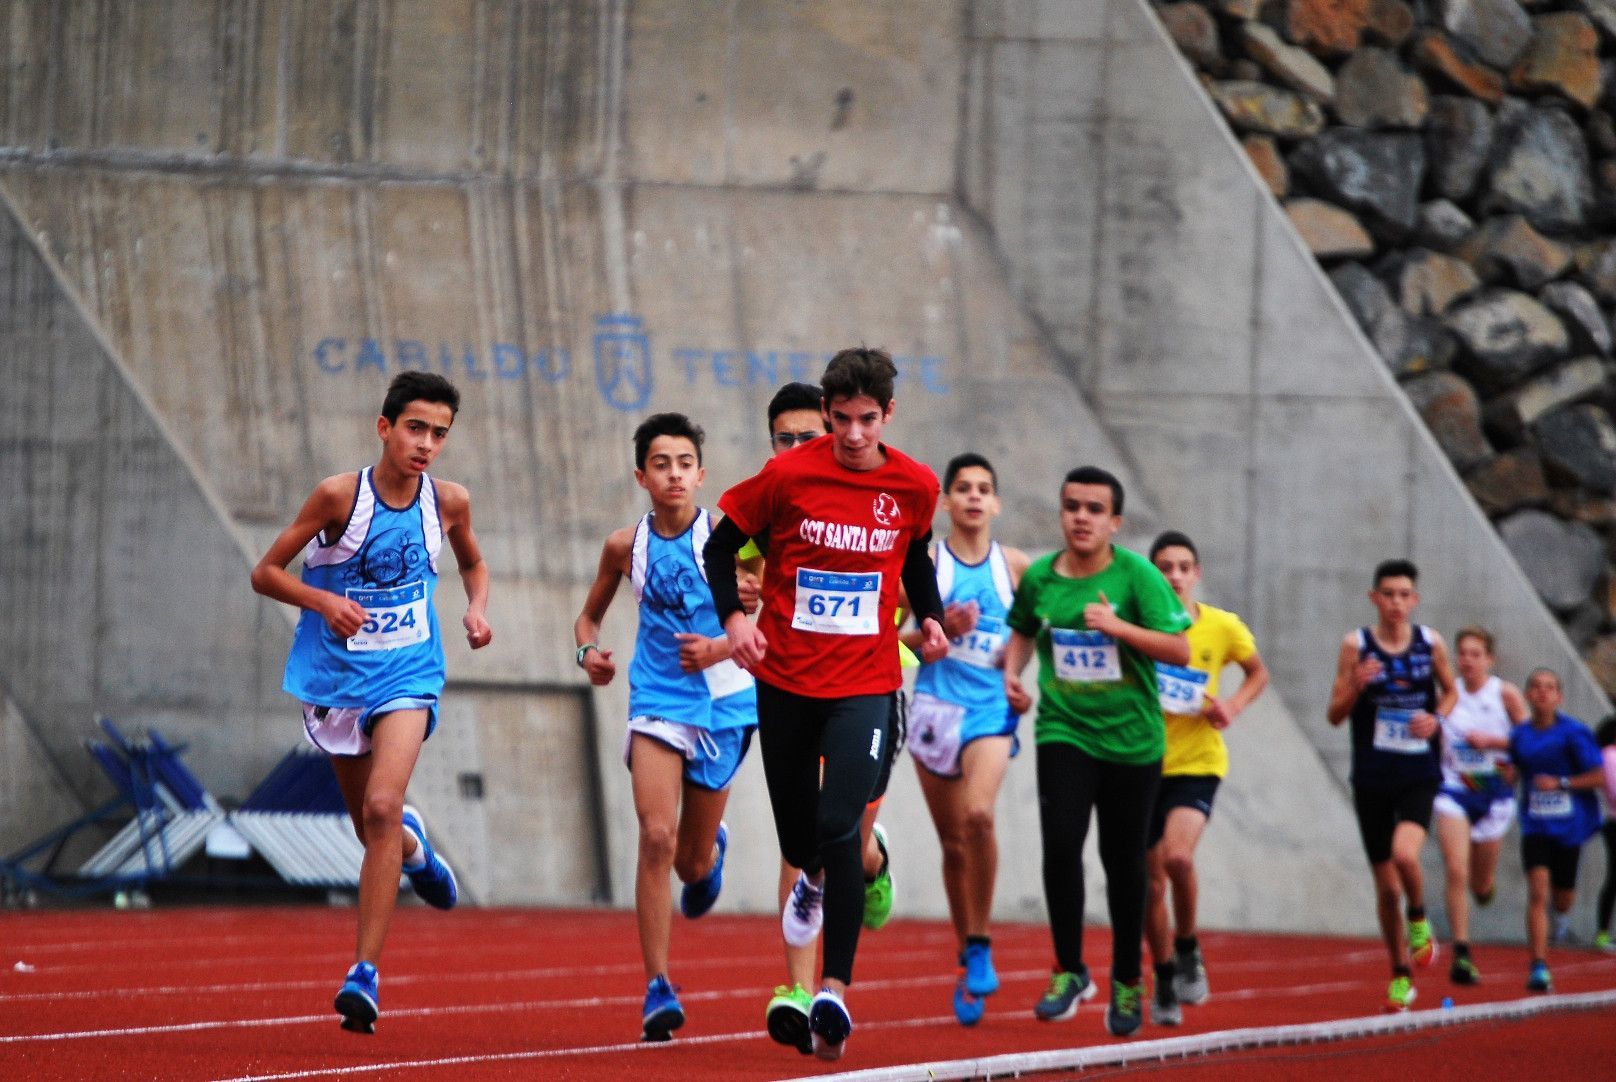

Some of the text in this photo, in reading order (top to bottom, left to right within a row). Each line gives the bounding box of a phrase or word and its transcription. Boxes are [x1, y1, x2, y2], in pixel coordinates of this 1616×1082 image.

[672, 347, 949, 394] TENEFE
[800, 518, 824, 545] CCT
[824, 522, 867, 552] SANTA
[808, 593, 860, 617] 671
[361, 607, 416, 634] 524
[1062, 650, 1105, 668] 412
